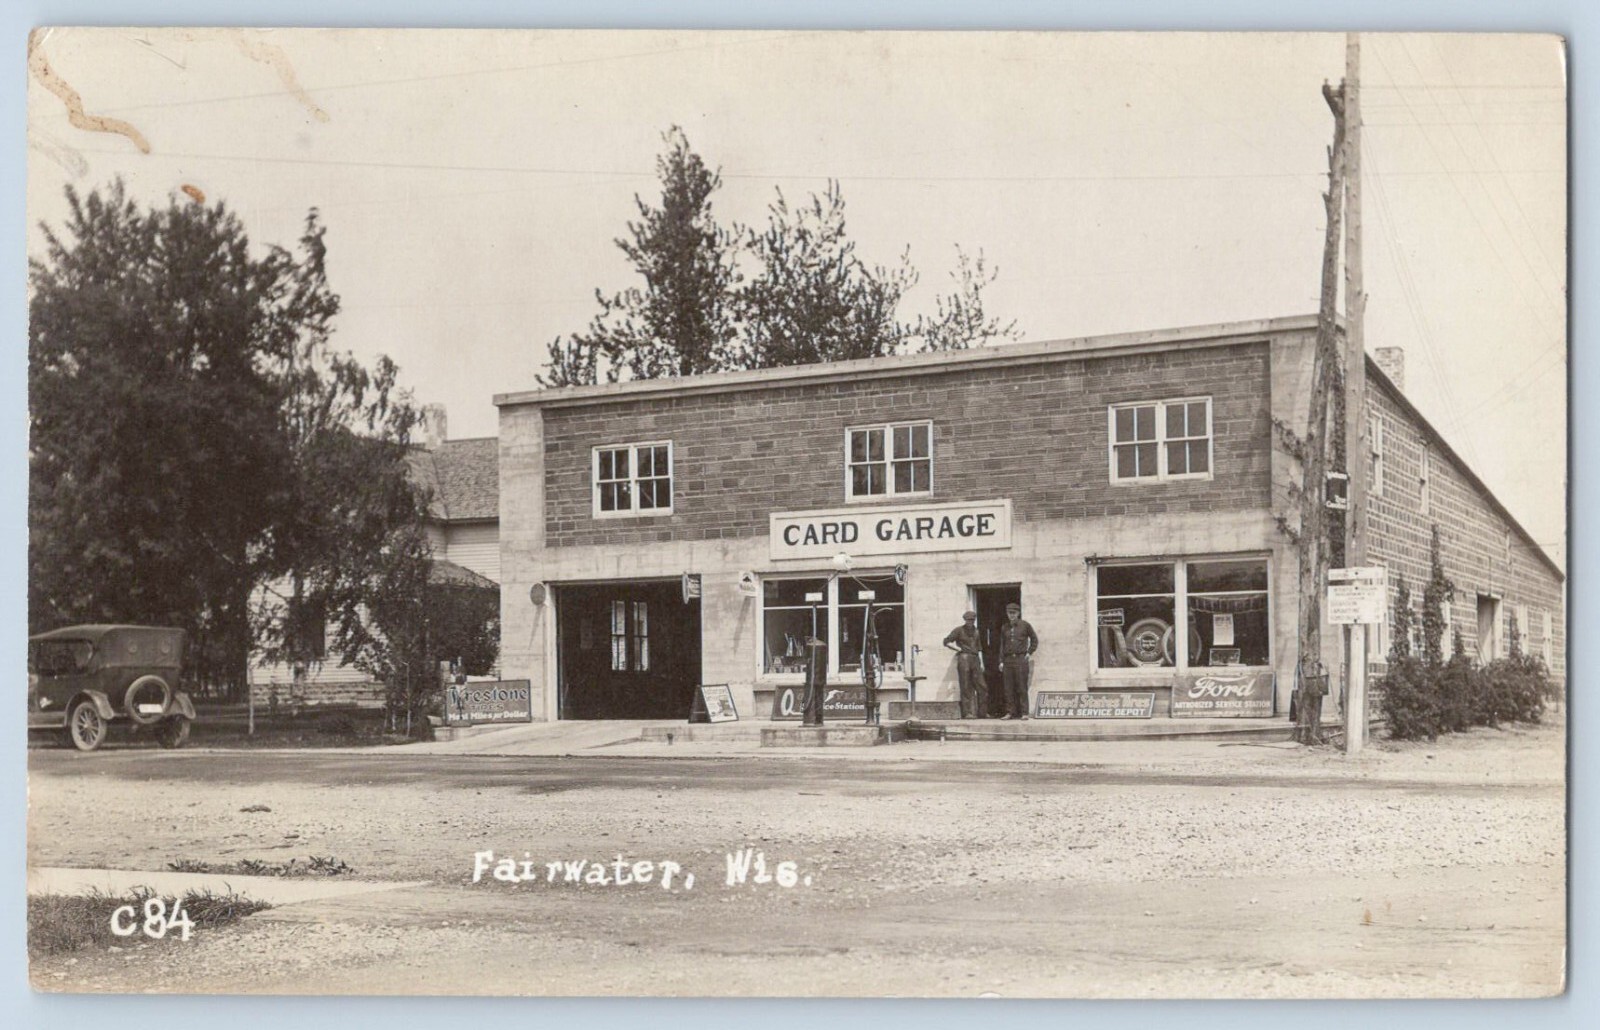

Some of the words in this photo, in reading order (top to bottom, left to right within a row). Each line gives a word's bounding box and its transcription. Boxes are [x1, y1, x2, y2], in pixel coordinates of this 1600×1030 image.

[784, 521, 859, 546] CARD
[875, 513, 996, 542] GARAGE
[1187, 675, 1256, 699] Ford
[1039, 708, 1066, 716] SALES
[1076, 708, 1112, 716] SERVICE
[1114, 708, 1146, 716] DEPOT
